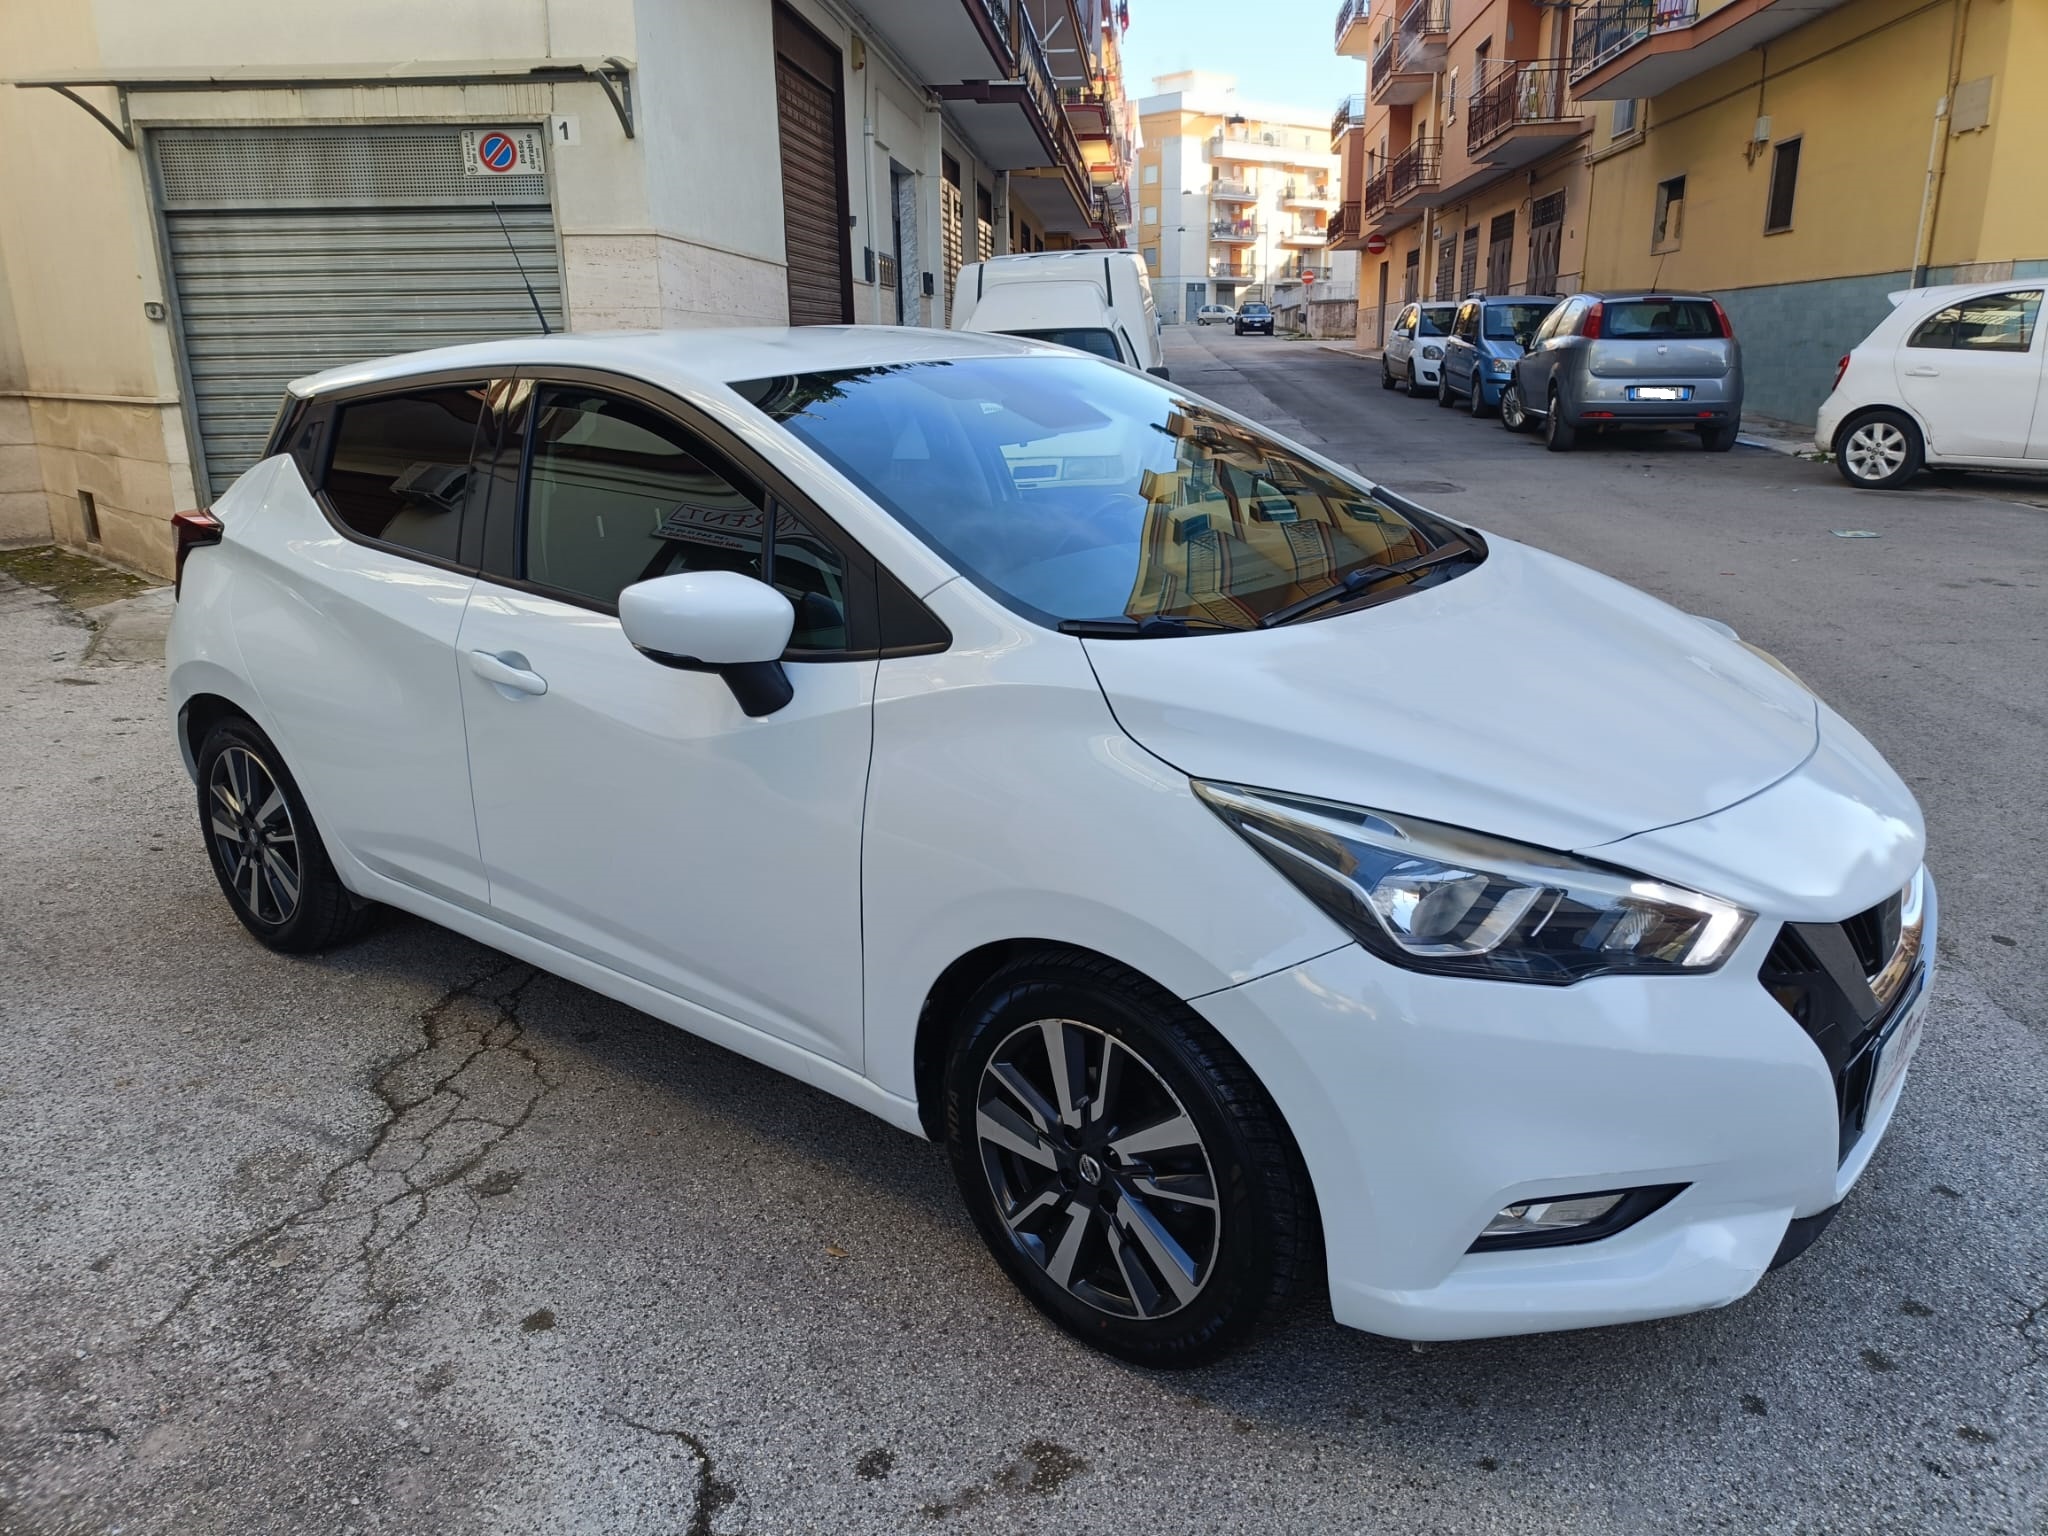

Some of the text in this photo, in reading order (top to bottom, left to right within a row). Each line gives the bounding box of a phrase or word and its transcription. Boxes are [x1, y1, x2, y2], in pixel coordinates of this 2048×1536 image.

[558, 121, 569, 141] 1
[518, 140, 527, 164] passo
[526, 133, 536, 170] carrabile
